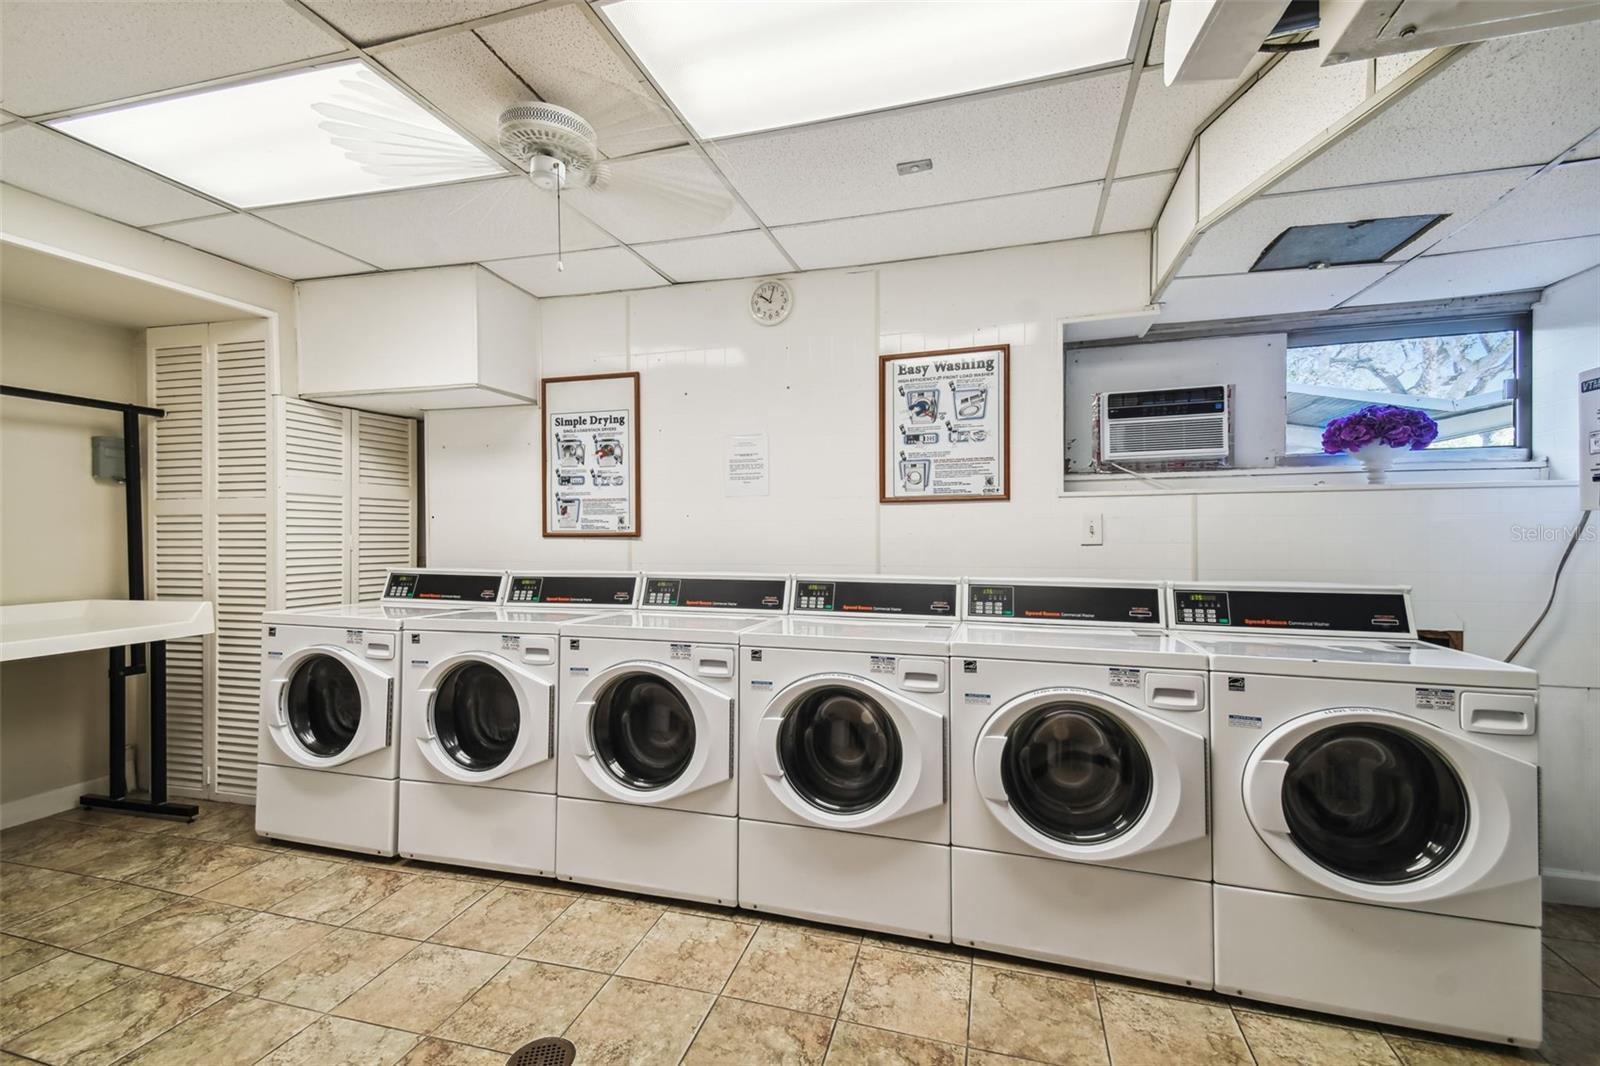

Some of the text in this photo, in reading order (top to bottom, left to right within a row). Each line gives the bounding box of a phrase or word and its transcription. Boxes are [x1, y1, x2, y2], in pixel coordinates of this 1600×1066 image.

[897, 359, 995, 377] Easy Washing
[554, 415, 625, 428] Simple Drying
